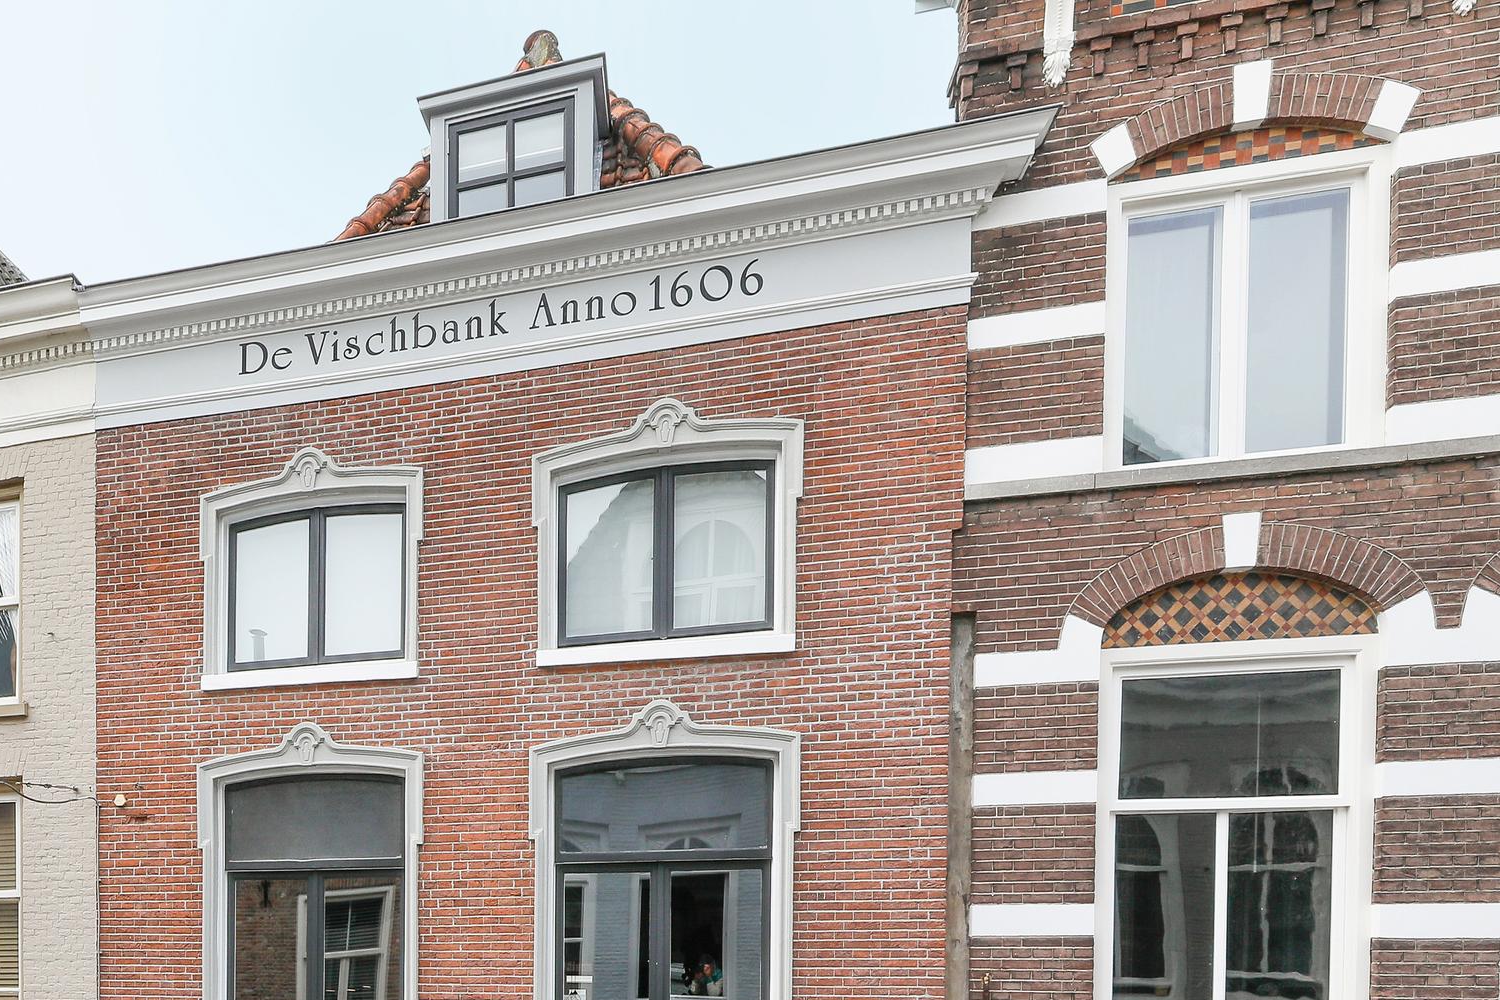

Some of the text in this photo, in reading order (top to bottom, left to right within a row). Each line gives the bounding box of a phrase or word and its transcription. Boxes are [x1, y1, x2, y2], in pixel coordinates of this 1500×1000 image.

[238, 258, 765, 376] De Vischbank Anno 1606
